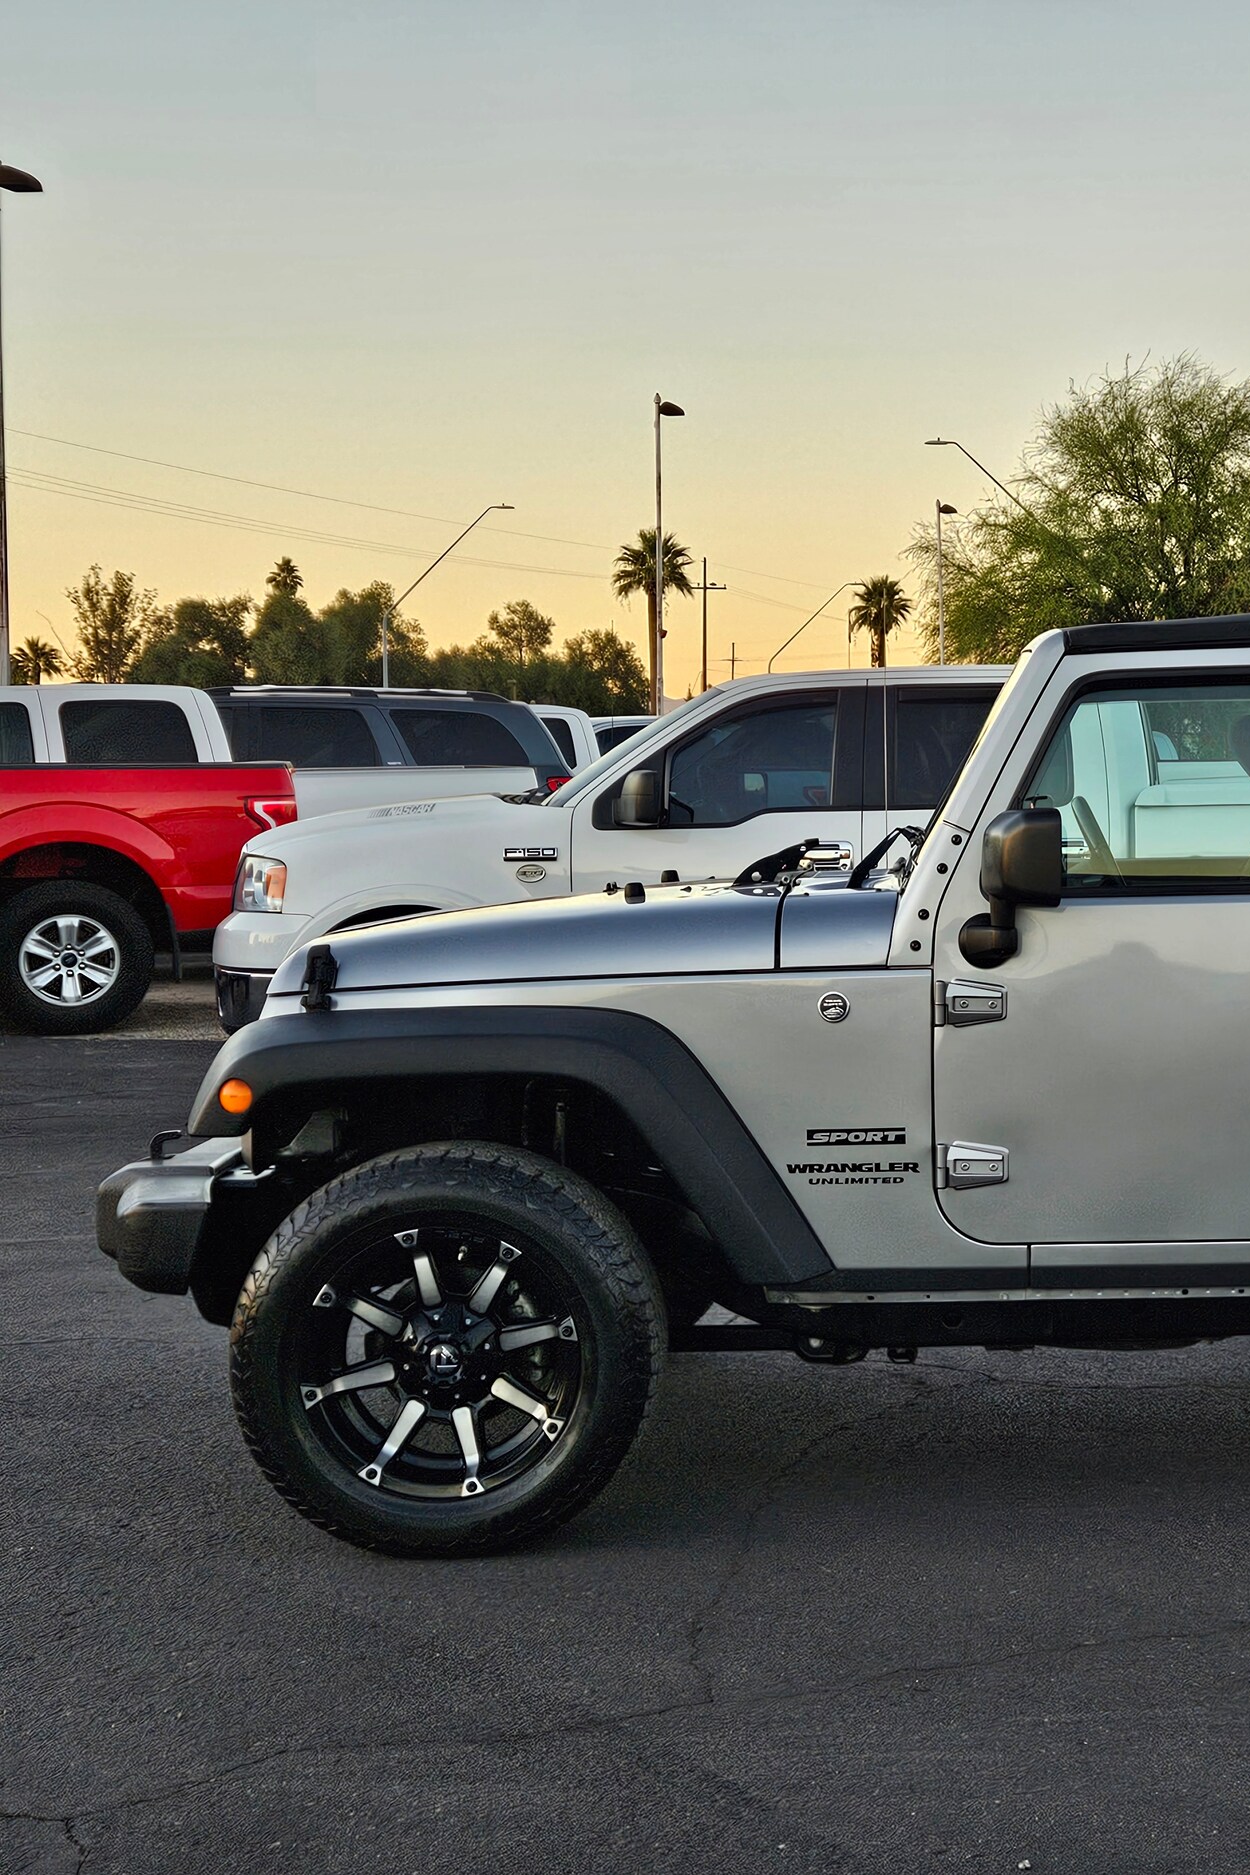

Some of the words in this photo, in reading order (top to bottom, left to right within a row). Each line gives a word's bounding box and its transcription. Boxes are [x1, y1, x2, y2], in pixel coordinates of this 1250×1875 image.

[806, 1130, 906, 1144] SPORT
[786, 1162, 921, 1174] WRANGLER
[808, 1176, 905, 1186] UNLIMITED
